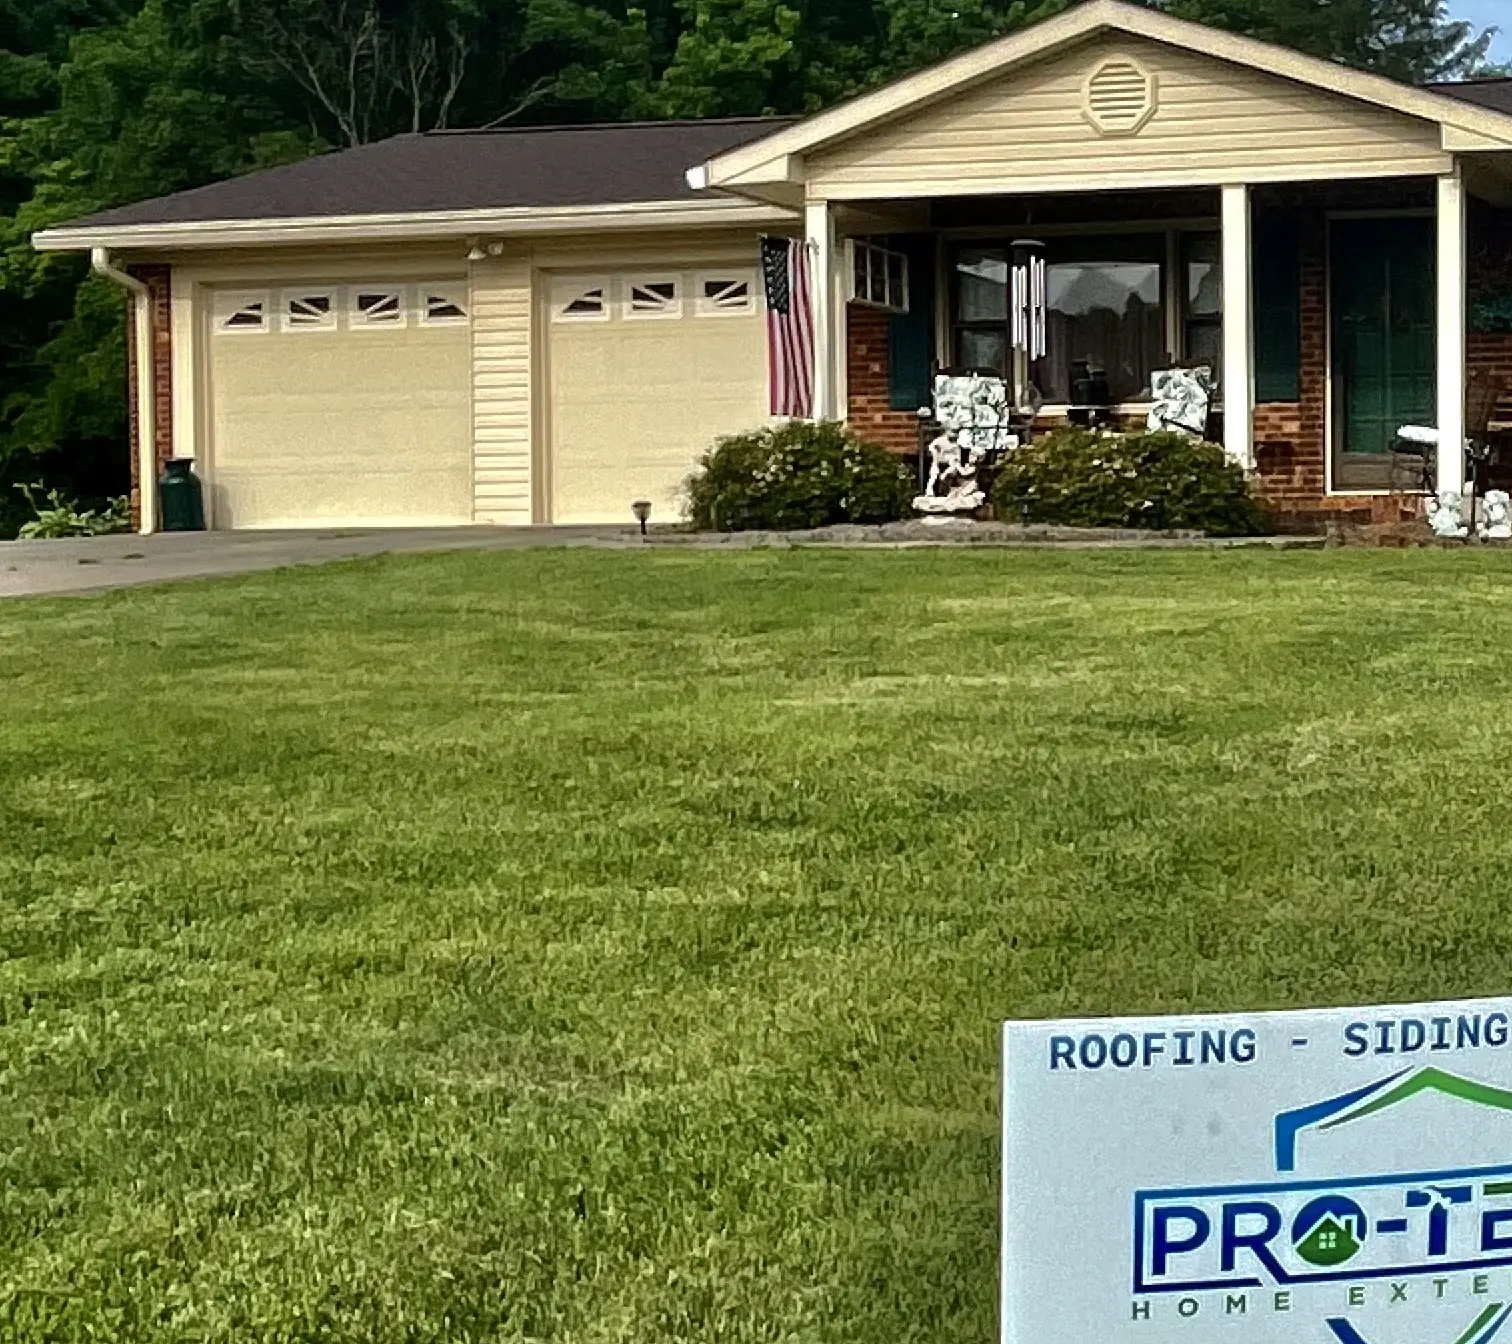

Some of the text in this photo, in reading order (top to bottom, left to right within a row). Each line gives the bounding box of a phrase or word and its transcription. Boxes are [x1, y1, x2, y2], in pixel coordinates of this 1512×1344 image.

[1050, 1029, 1256, 1070] ROOFING
[1291, 1038, 1308, 1047] -
[1343, 1012, 1509, 1055] SIDING
[1131, 1291, 1290, 1320] HOME
